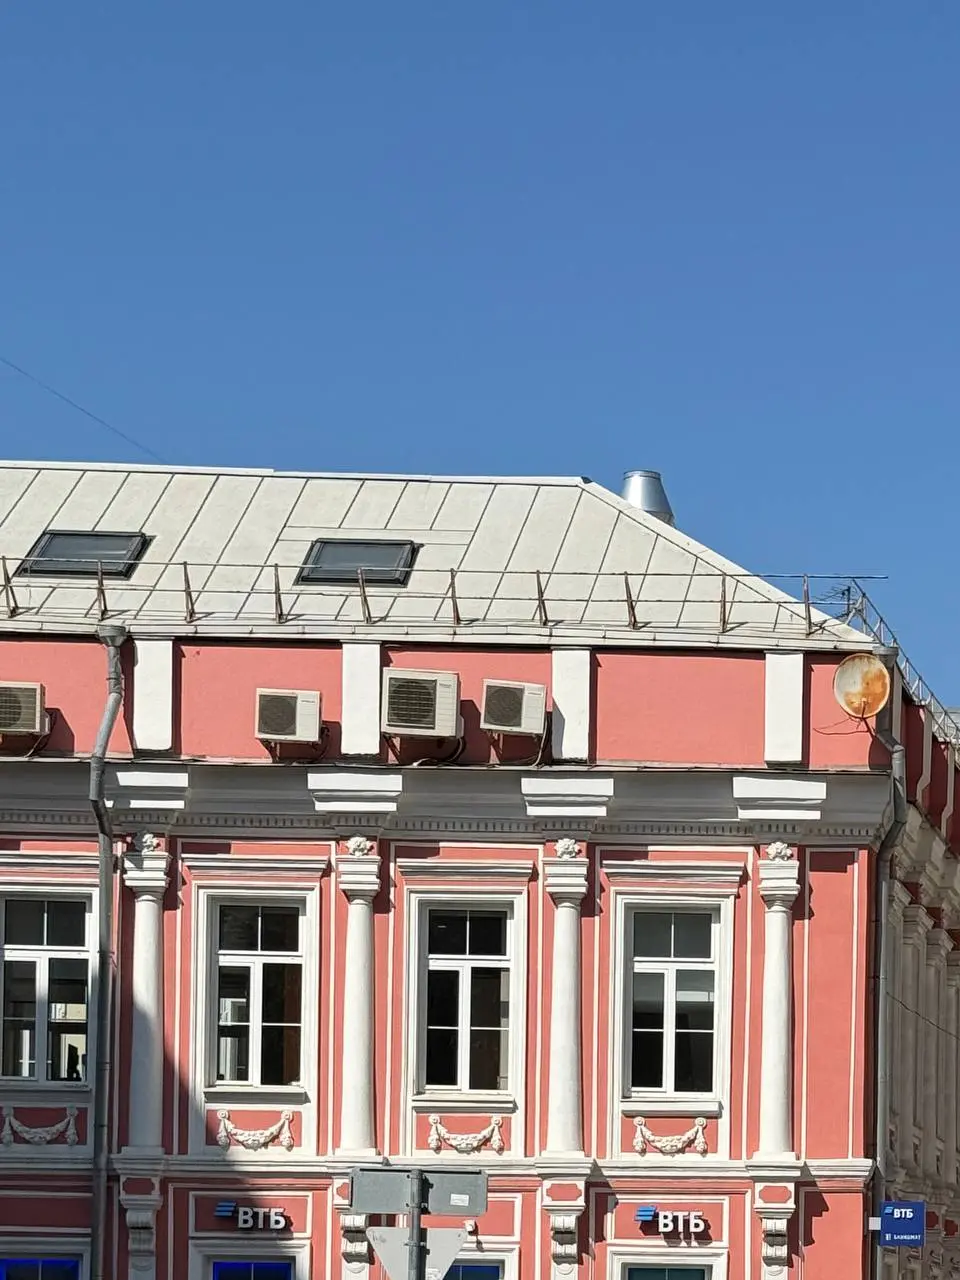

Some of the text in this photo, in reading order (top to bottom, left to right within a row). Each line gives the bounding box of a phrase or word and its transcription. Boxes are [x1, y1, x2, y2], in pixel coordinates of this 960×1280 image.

[237, 1206, 287, 1230] ВТБ
[658, 1211, 706, 1233] ВТБ
[893, 1208, 914, 1219] ВТБ
